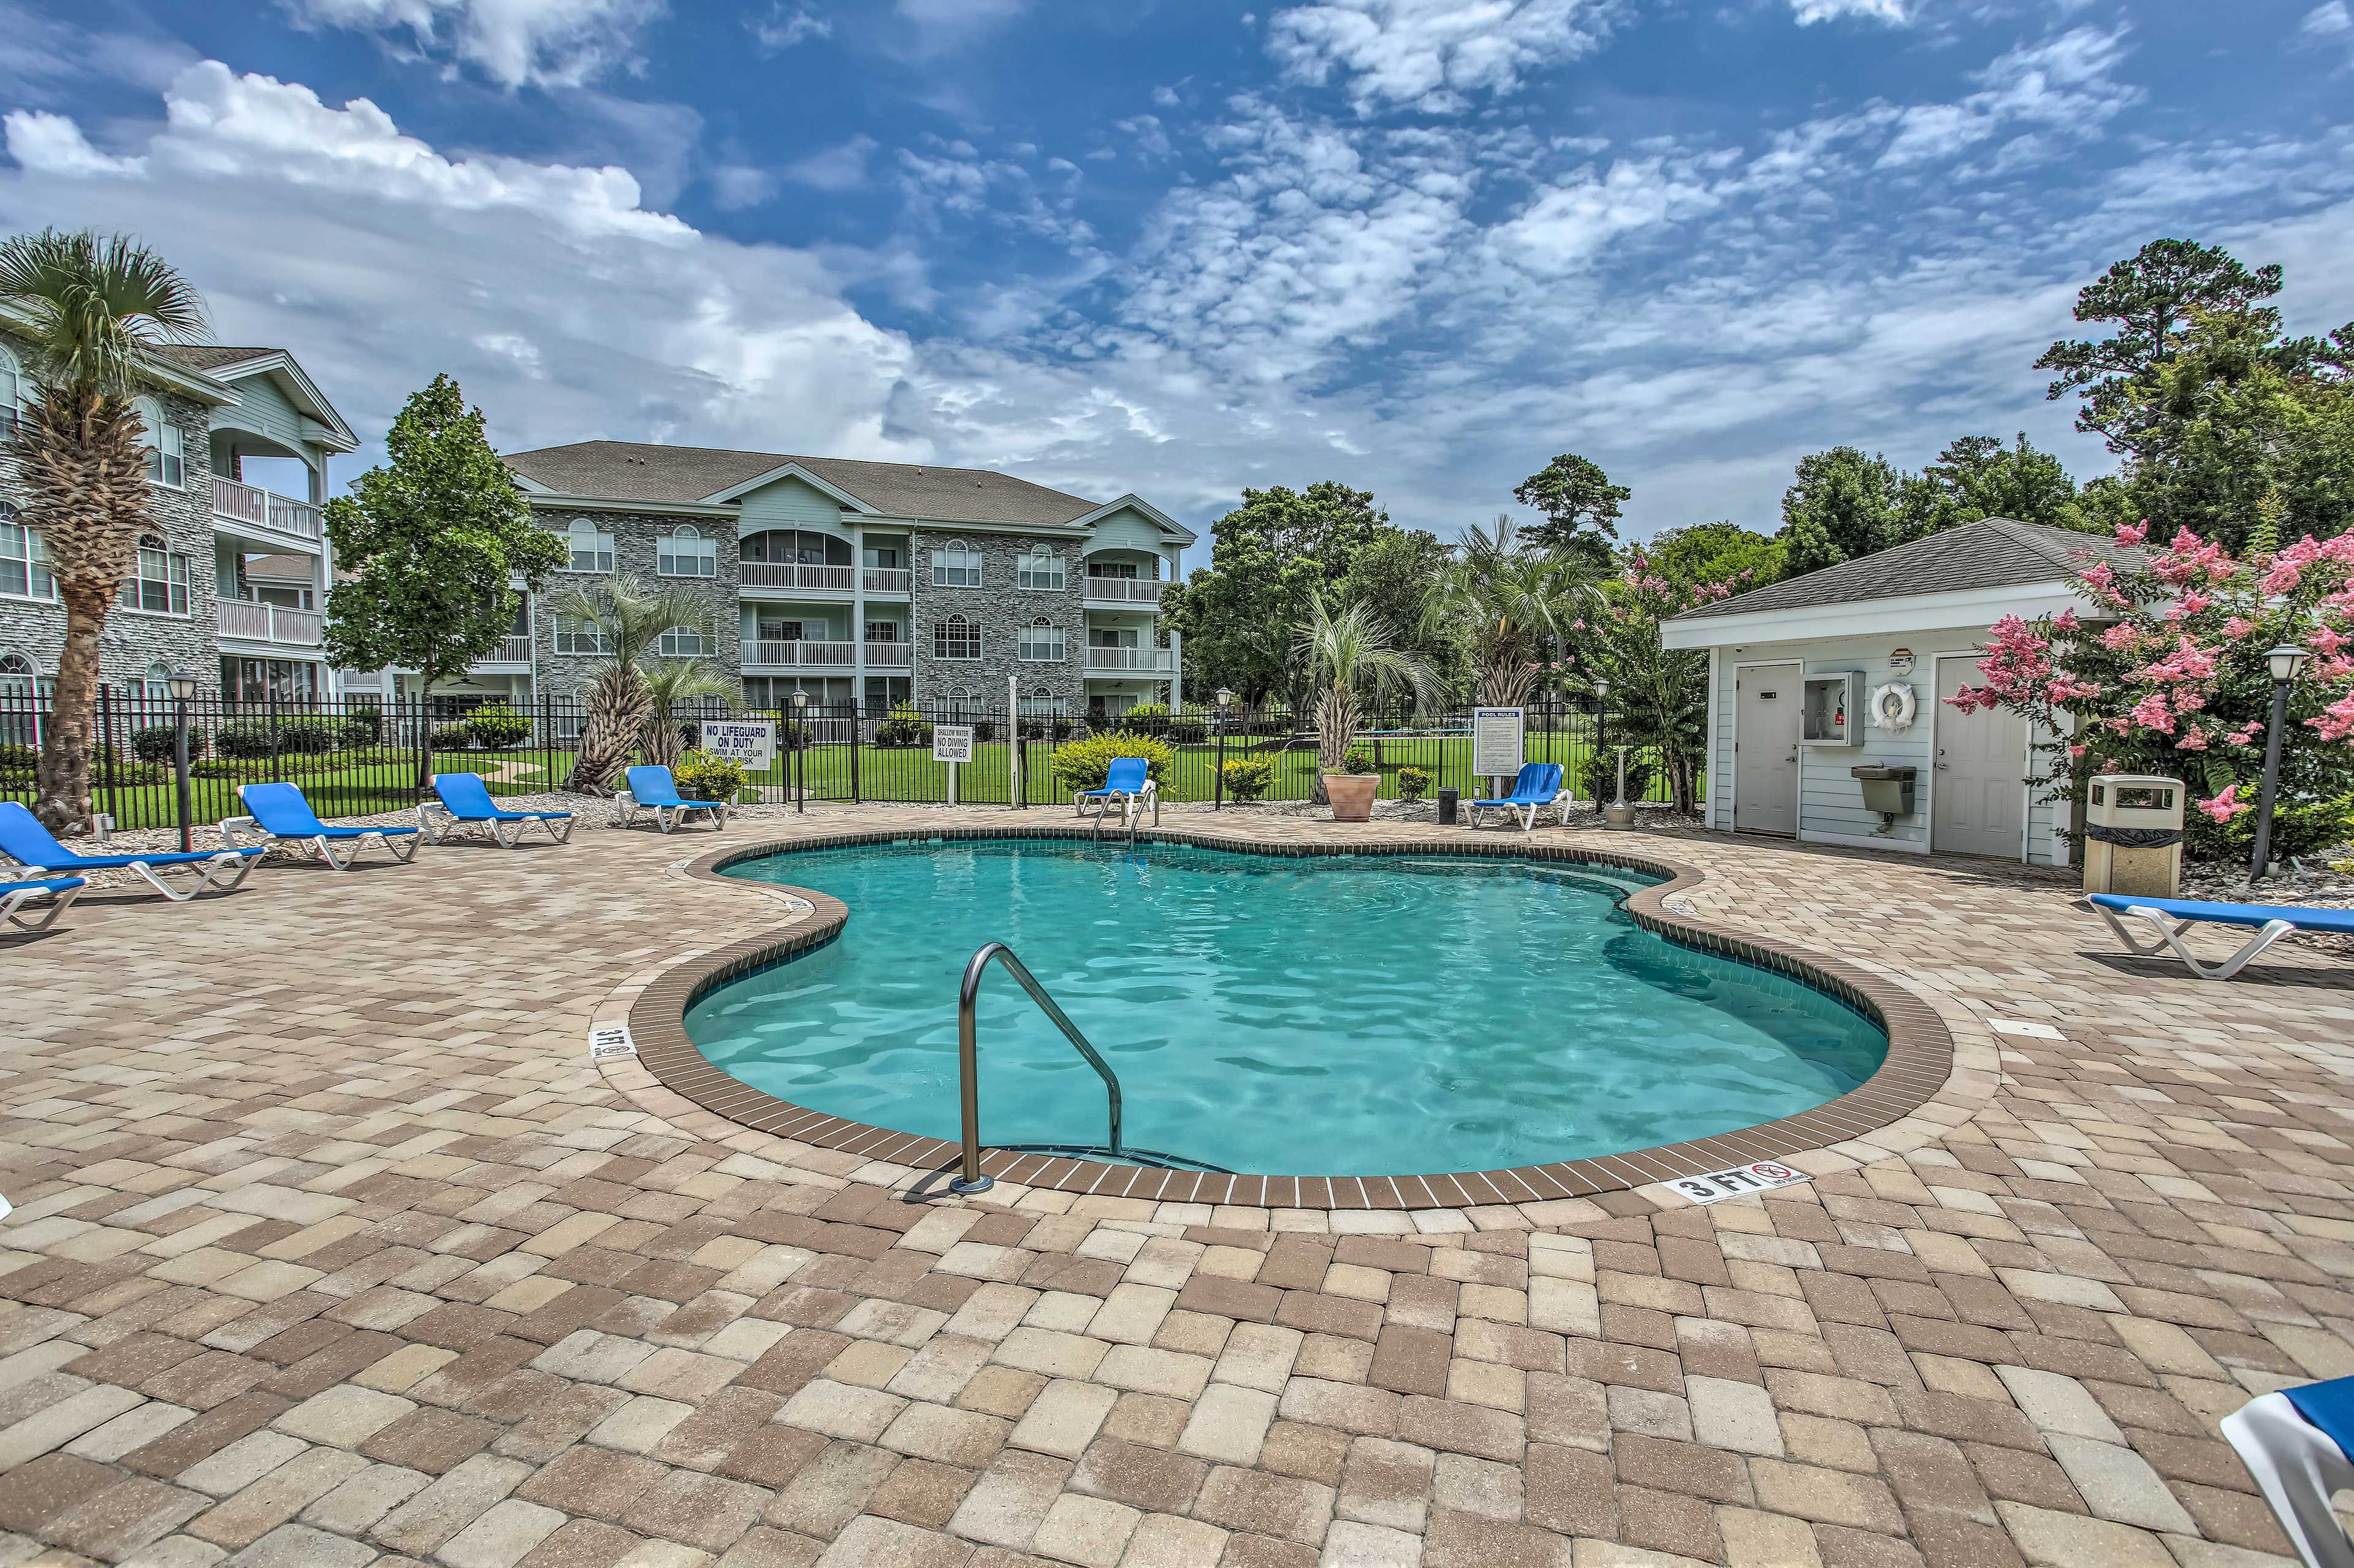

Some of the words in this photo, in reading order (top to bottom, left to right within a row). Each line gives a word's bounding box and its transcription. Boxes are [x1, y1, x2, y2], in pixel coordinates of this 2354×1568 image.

[706, 725, 718, 736] NO
[722, 726, 766, 738] LIFEGUARD
[718, 737, 729, 747] ON
[733, 737, 754, 748] DUTY
[937, 737, 946, 747] NO
[948, 738, 967, 747] DIVING
[937, 748, 967, 758] ALLOWED
[596, 1036, 625, 1046] FT
[1679, 1181, 1715, 1196] 3
[1707, 1171, 1762, 1191] FT
